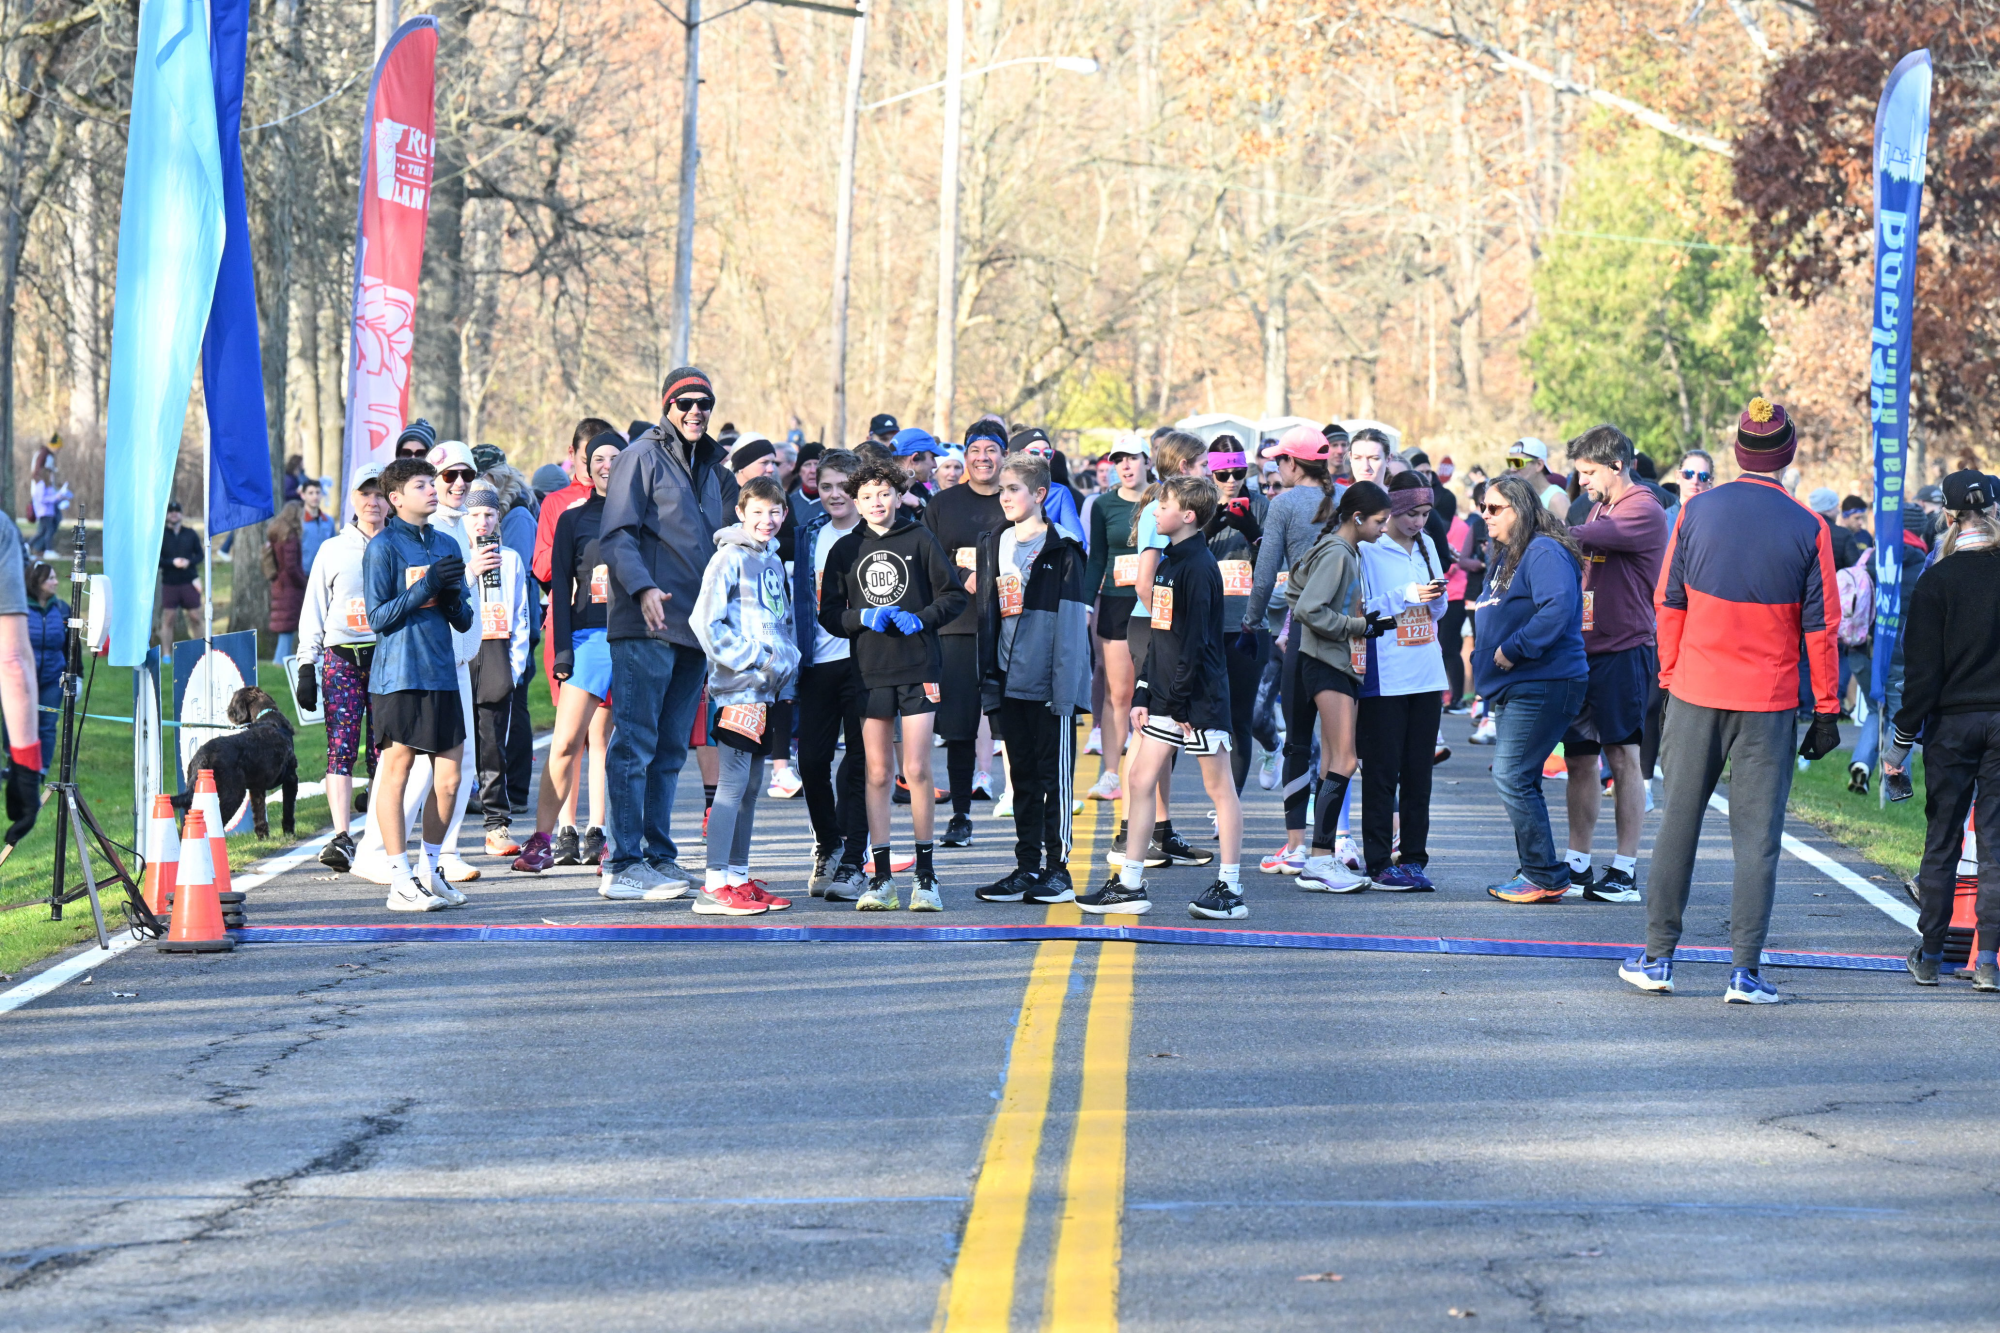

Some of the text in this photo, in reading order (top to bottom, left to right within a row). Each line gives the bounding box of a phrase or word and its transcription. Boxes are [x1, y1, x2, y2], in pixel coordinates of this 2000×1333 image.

[408, 163, 425, 177] THE
[393, 181, 431, 210] LAN
[1880, 437, 1902, 512] Road
[873, 553, 888, 562] OHIO
[410, 570, 426, 580] FA
[871, 571, 893, 588] OBC
[1226, 577, 1241, 588] 74
[351, 600, 366, 608] FA
[999, 595, 1008, 609] 01
[356, 614, 368, 626] 11
[482, 620, 496, 632] 49
[1406, 624, 1430, 638] 1272
[1357, 654, 1366, 666] 12
[730, 709, 759, 732] 1102
[617, 875, 643, 889] HOKA
